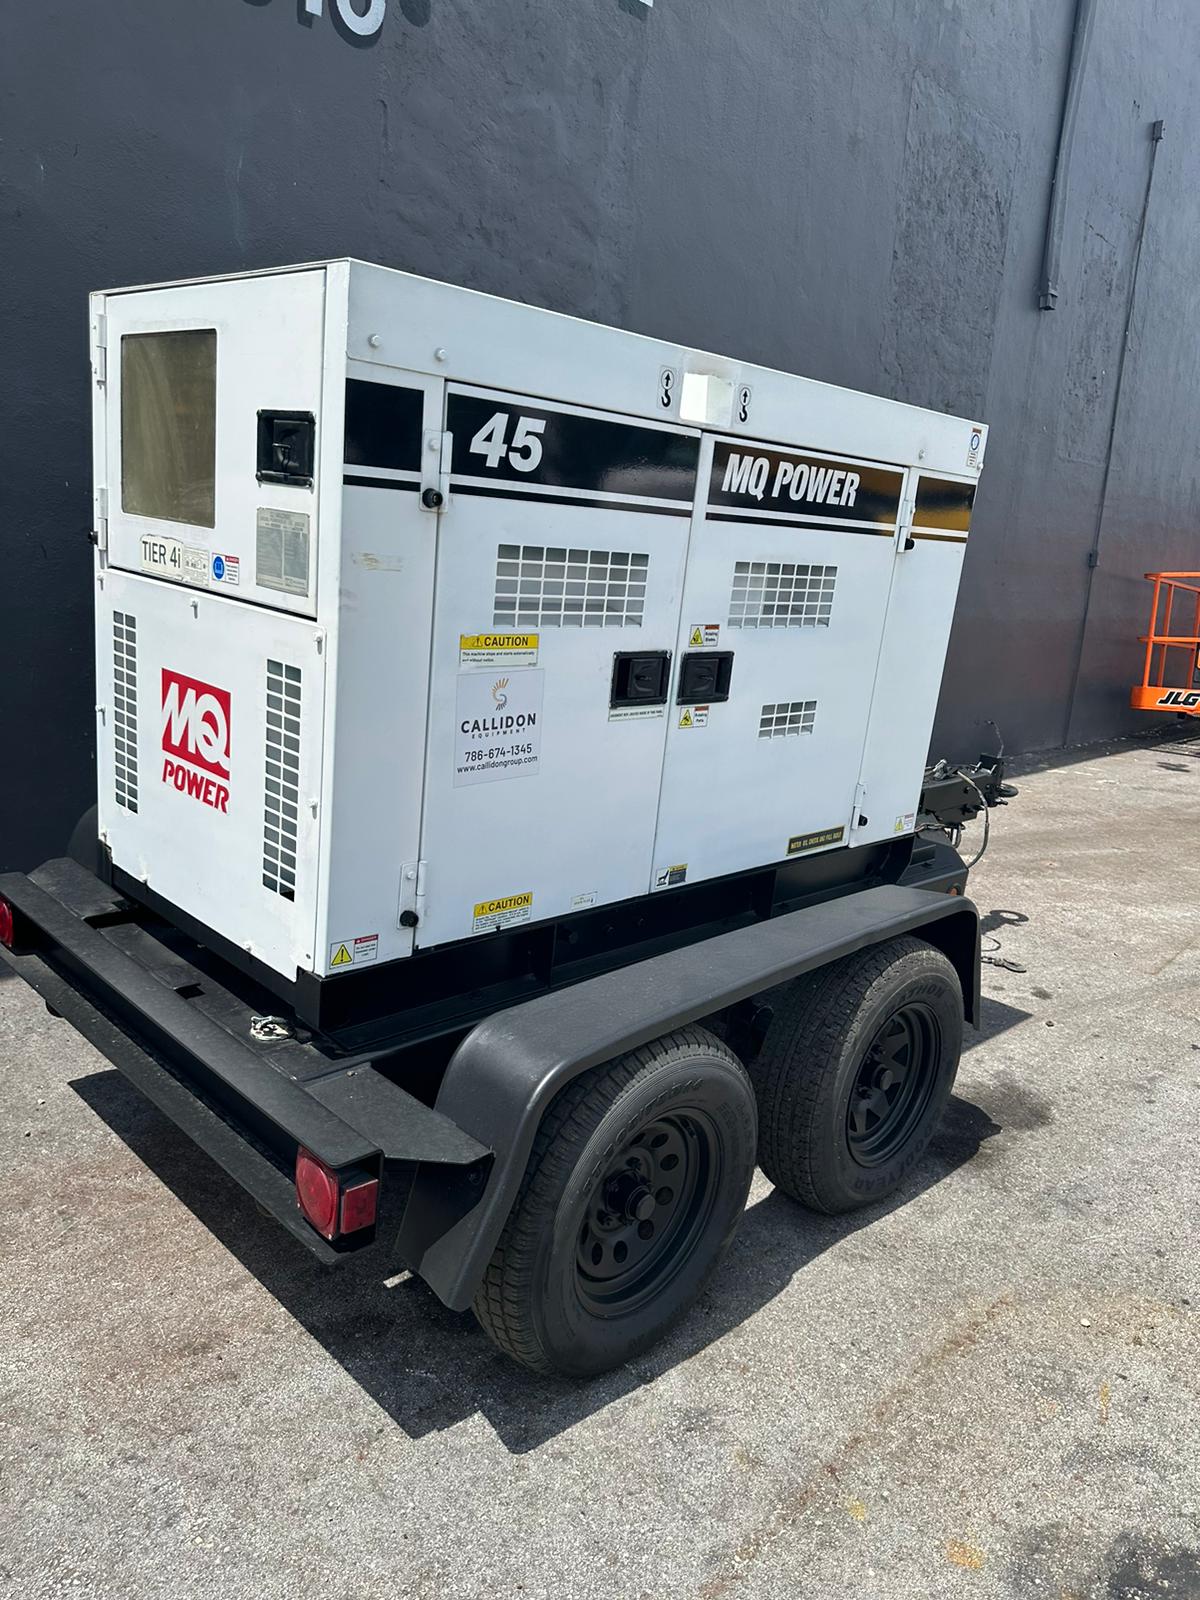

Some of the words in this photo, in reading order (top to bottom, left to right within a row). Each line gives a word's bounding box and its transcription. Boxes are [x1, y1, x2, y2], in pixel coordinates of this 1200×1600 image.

[469, 412, 547, 472] 45
[721, 453, 770, 501] MQ
[771, 461, 861, 507] POWER
[142, 540, 167, 566] TIER
[170, 546, 181, 569] 4i
[484, 636, 529, 647] CAUTION
[1157, 690, 1200, 707] JLG
[162, 681, 230, 773] MQ
[461, 712, 537, 734] CALLIDON
[472, 727, 526, 739] EQUIPMENT
[464, 743, 533, 763] 786-674-1345
[456, 756, 538, 774] www.callidongroup.com
[162, 758, 231, 814] POWER
[488, 895, 530, 912] CAUTION
